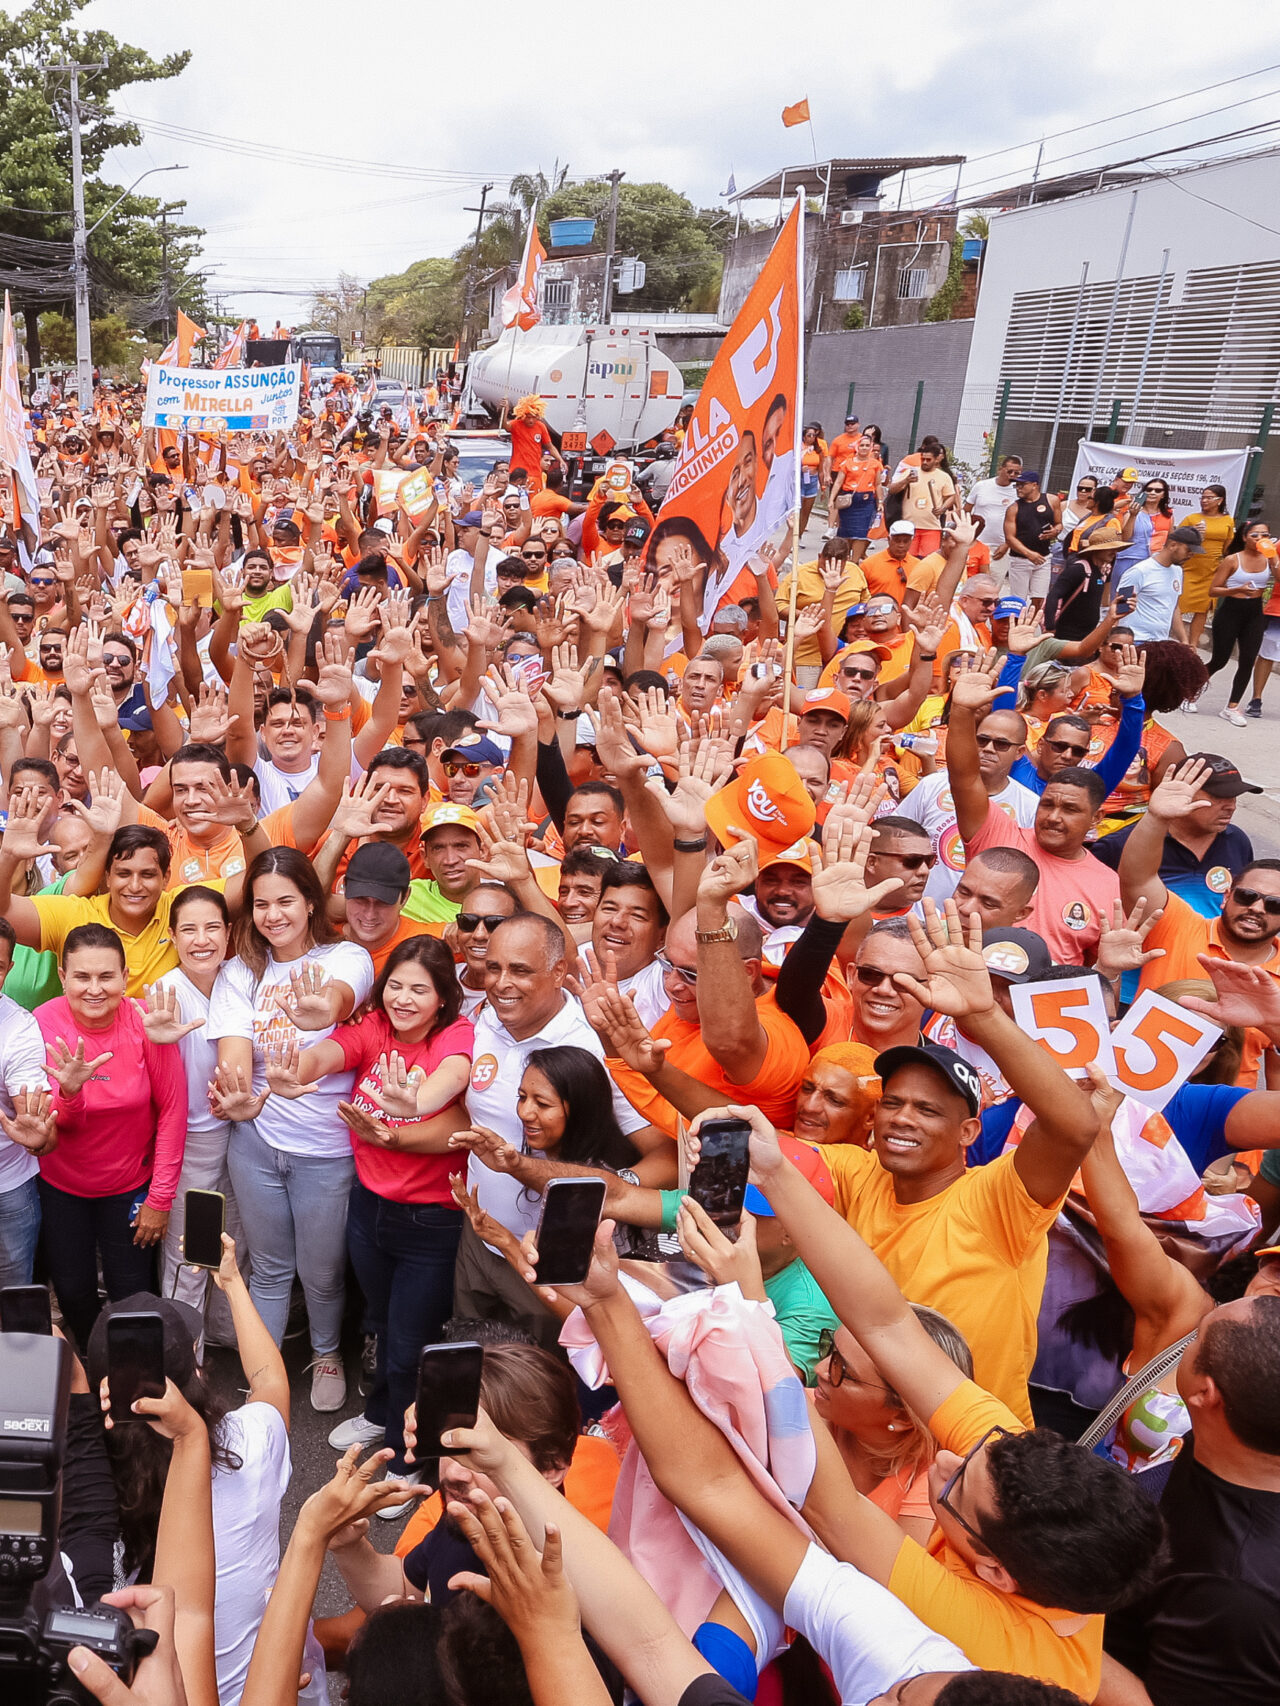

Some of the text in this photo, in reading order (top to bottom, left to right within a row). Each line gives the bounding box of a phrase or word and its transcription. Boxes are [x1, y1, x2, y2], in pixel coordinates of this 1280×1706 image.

[159, 367, 295, 391] Professor ASSUNÇÃO
[157, 395, 180, 406] com
[183, 391, 253, 412] MIRELLA
[271, 416, 288, 424] PDT
[563, 441, 584, 449] 3475
[1106, 467, 1121, 475] LOCA
[1138, 470, 1160, 478] CIONAM
[1170, 471, 1194, 481] SEÇÕES
[402, 474, 427, 503] 55
[1187, 487, 1204, 495] ESCO
[747, 778, 777, 815] YOU
[432, 807, 461, 825] 55
[936, 815, 955, 832] Rosa
[184, 861, 200, 877] 55
[1211, 871, 1226, 885] 55
[986, 952, 1022, 971] 55
[258, 1028, 297, 1044] ANDAR
[472, 1064, 495, 1083] 55
